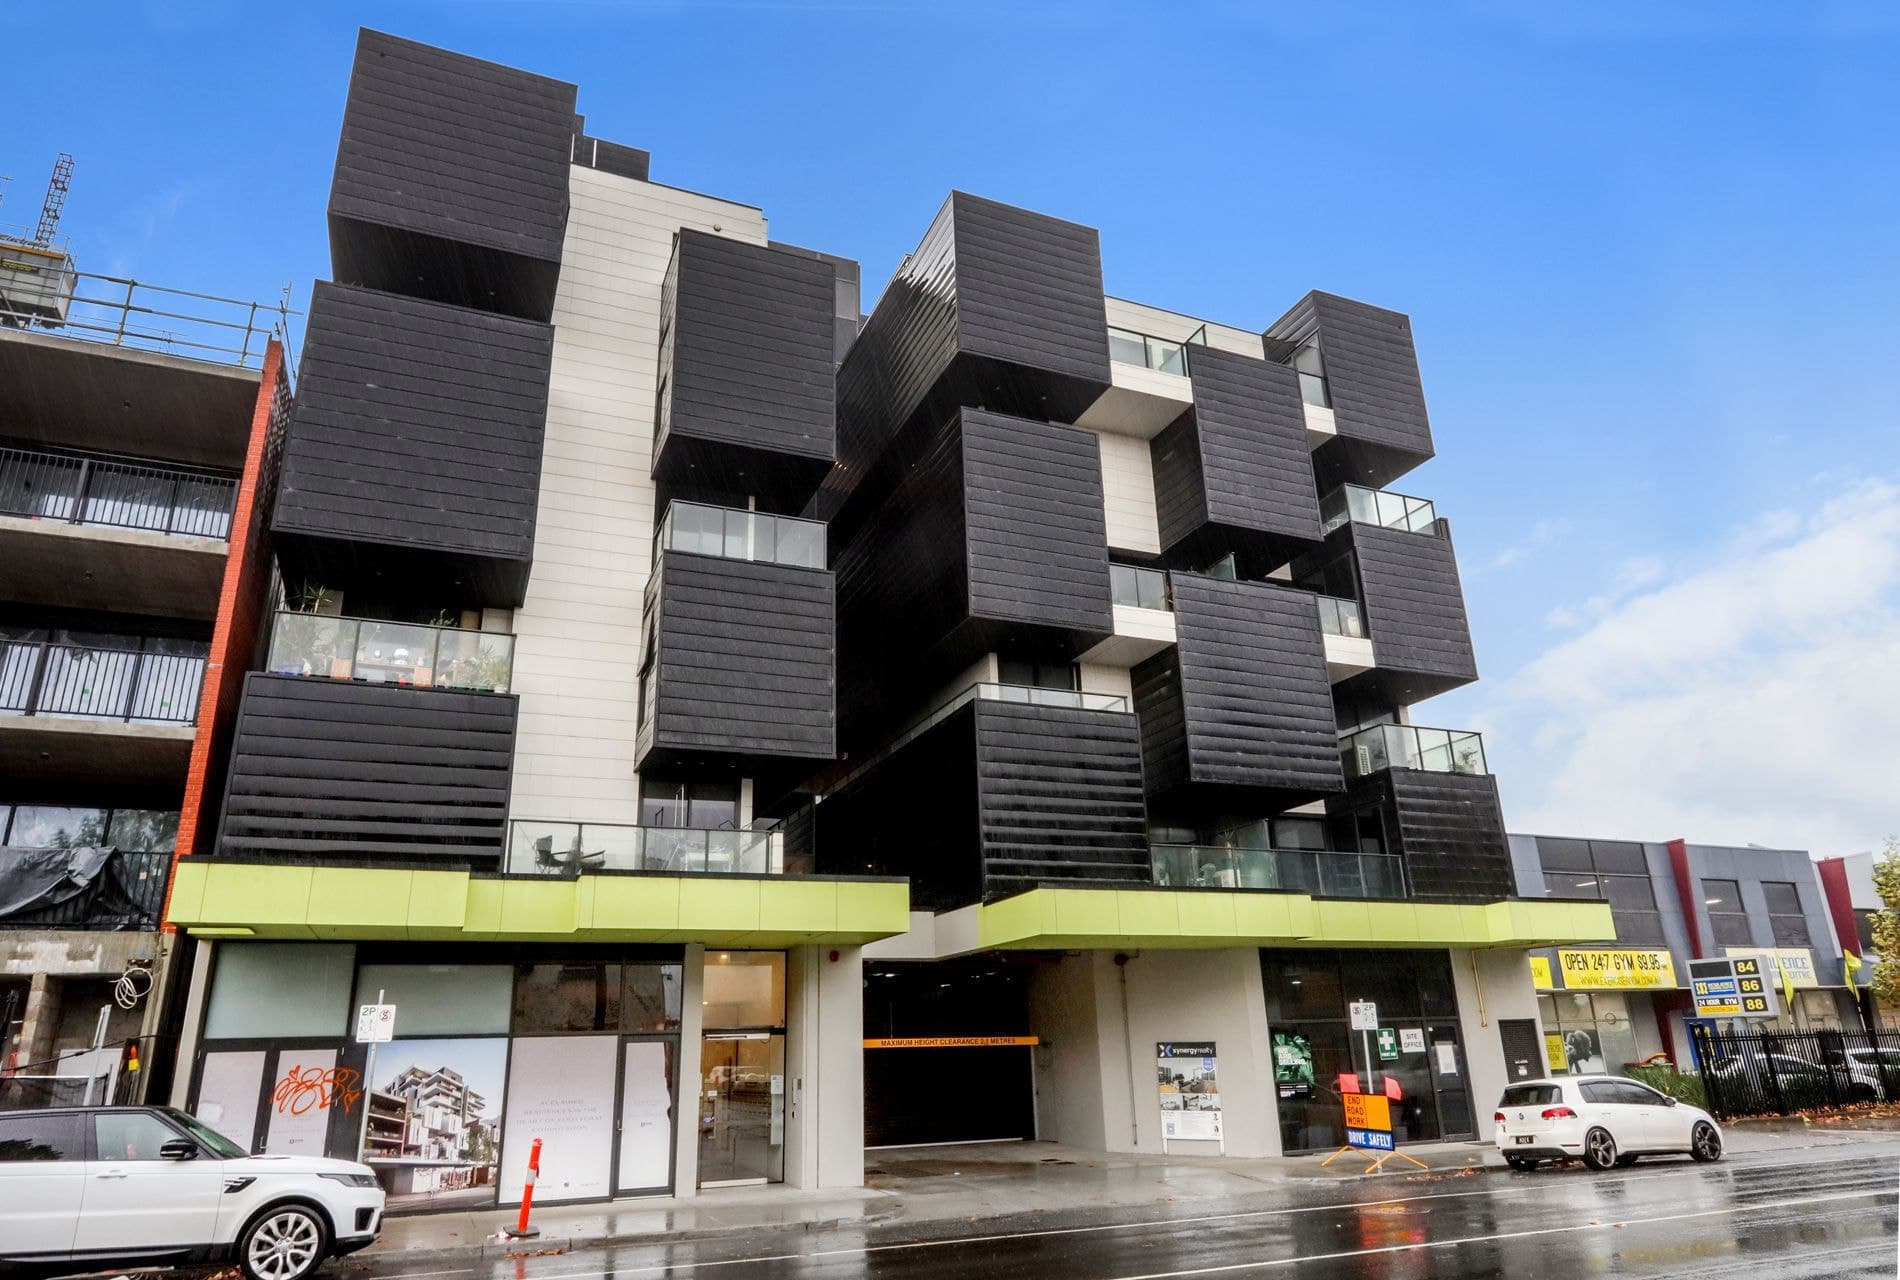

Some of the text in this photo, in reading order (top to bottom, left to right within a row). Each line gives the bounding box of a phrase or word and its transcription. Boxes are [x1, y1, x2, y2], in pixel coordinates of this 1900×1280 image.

[1564, 953, 1589, 971] OPEN
[1613, 953, 1636, 971] GYM
[1637, 953, 1661, 971] $9.95
[1736, 961, 1755, 973] 84
[1741, 979, 1760, 992] 86
[1698, 998, 1706, 1006] 24
[1724, 997, 1738, 1005] GYM
[1745, 998, 1764, 1010] 88
[362, 1007, 376, 1016] 2P
[881, 1039, 913, 1047] MAXIMUM
[1347, 1096, 1361, 1105] END
[1347, 1107, 1364, 1115] ROAD
[1347, 1117, 1366, 1125] WORK
[1348, 1131, 1392, 1147] DRIVE SAFELY
